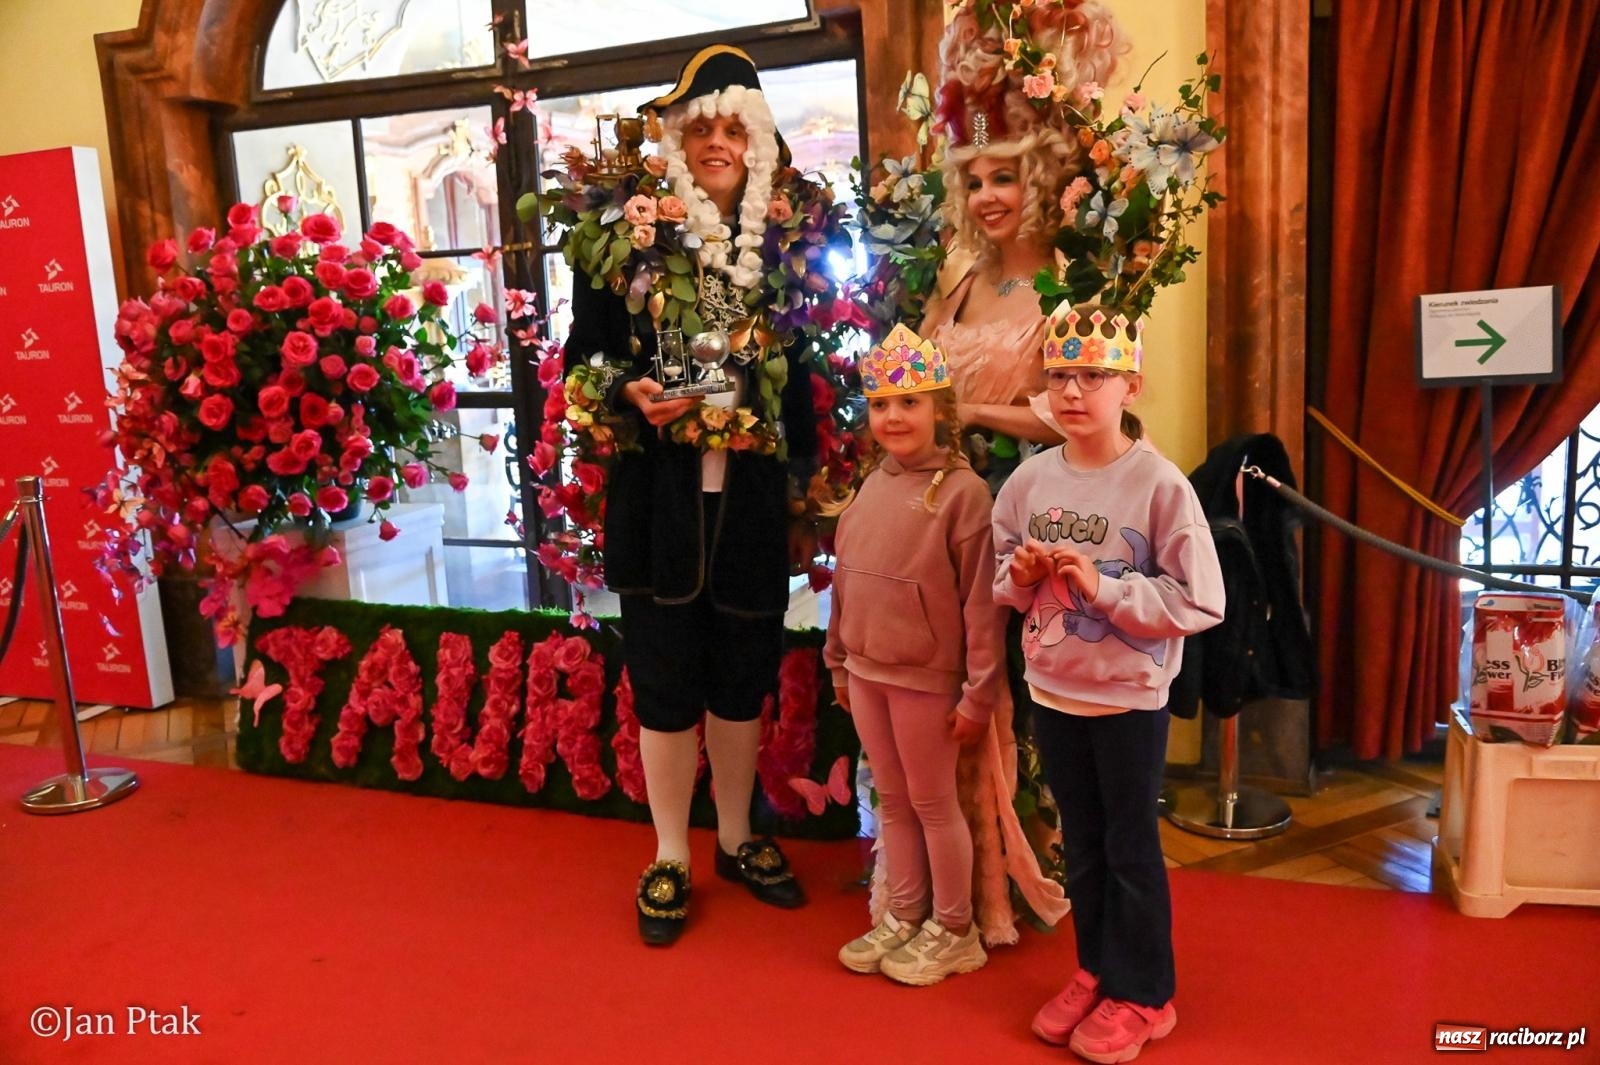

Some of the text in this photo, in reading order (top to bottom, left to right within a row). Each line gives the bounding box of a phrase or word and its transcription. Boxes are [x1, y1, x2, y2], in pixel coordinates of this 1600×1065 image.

[0, 217, 30, 229] AURON
[38, 281, 74, 293] TAURON
[15, 350, 50, 360] TAURON
[0, 415, 27, 424] AURON
[57, 414, 93, 424] TAURON
[59, 601, 88, 610] AURON
[96, 662, 131, 673] TAURON
